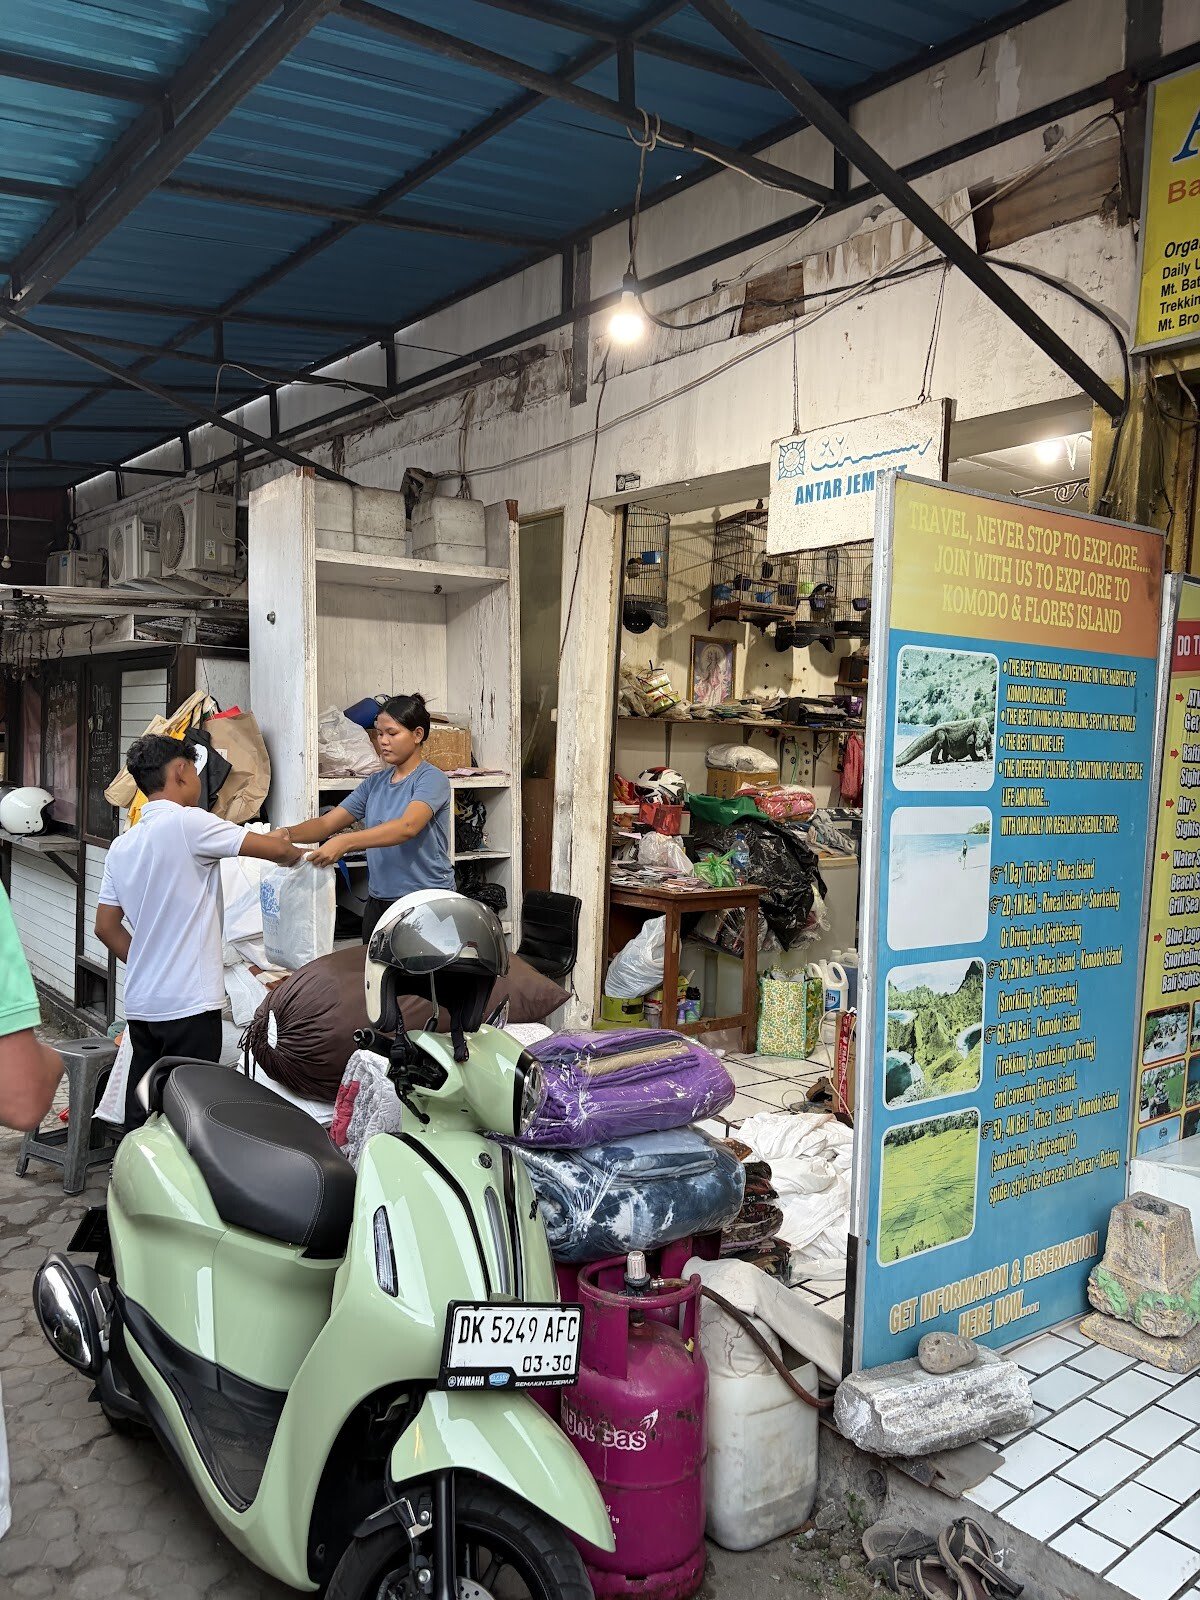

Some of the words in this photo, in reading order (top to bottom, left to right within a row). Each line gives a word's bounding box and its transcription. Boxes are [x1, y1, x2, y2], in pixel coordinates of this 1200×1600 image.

[1164, 238, 1200, 259] Orga
[1162, 261, 1191, 280] Daily
[1160, 283, 1178, 297] Mt.
[1158, 318, 1175, 333] Mt.
[1179, 313, 1200, 327] Bro
[794, 477, 843, 506] ANTAR
[845, 464, 908, 496] JEM
[908, 502, 974, 546] TRAVEL,
[976, 514, 1025, 550] NEVER
[1027, 528, 1062, 557] STOP
[1064, 533, 1082, 560] TO
[934, 545, 971, 576] JOIN
[973, 550, 1013, 585] WITH
[1015, 560, 1034, 587] US
[1035, 562, 1053, 590] TO
[1055, 565, 1113, 601] EXPLORE
[1114, 577, 1131, 604] TO
[942, 584, 1010, 620] KOMODO
[1011, 594, 1022, 622] &
[1024, 596, 1074, 630] FLORES
[1076, 605, 1122, 636] ISLAND
[1177, 635, 1191, 657] DO
[1008, 658, 1020, 677] THE
[1020, 659, 1034, 678] BEST
[1035, 660, 1062, 681] TREKKING
[1062, 664, 1092, 684] ADVENTURE
[1092, 667, 1099, 684] IN
[1099, 667, 1109, 686] THE
[1109, 669, 1130, 688] HABITAT
[1129, 671, 1137, 688] OF
[1007, 684, 1032, 704] KOMODO
[1032, 685, 1054, 705] DRAGON
[1054, 687, 1067, 706] LIVE
[1006, 706, 1018, 726] THE
[1018, 707, 1033, 727] BEST
[1033, 708, 1052, 728] DIVING
[1052, 710, 1060, 728] OR
[1089, 713, 1103, 731] SPOT
[1102, 713, 1109, 731] IN
[1109, 714, 1119, 732] THE
[1119, 714, 1137, 733] WORLD
[1184, 712, 1200, 733] Get
[1004, 732, 1016, 751] THE
[1016, 733, 1032, 752] BEST
[1031, 734, 1053, 753] NATURE
[1053, 735, 1064, 753] LIFE
[1004, 758, 1016, 778] THE
[1015, 758, 1046, 779] DIFFERENT
[1046, 759, 1070, 780] CULTURE
[1070, 759, 1076, 780] &
[1075, 760, 1103, 780] TRADITION
[1102, 760, 1110, 780] OF
[1110, 761, 1125, 781] LOCAL
[1125, 762, 1144, 781] PEOPLE
[1001, 787, 1015, 807] LIFE
[1015, 787, 1027, 807] AND
[1000, 815, 1016, 836] WITH
[1016, 815, 1029, 836] OUR
[1029, 815, 1045, 836] DAILY
[1045, 815, 1053, 835] OR
[1053, 814, 1077, 835] REGULAR
[1077, 814, 1103, 834] SCHEDULE
[1173, 849, 1196, 869] Water
[1003, 861, 1008, 884] 1
[1009, 861, 1023, 889] Day
[1023, 860, 1037, 888] Trip
[1037, 859, 1052, 883] Bali
[1056, 858, 1075, 881] Rinca
[1076, 857, 1096, 880] Island
[1170, 872, 1195, 892] Beach
[1023, 891, 1037, 915] Bali
[1063, 888, 1083, 911] Island
[1088, 885, 1121, 912] Snorkeling
[1168, 896, 1186, 916] Grill
[1185, 895, 1200, 914] Sea
[1000, 925, 1010, 949] Or
[1009, 924, 1032, 951] Diving
[1032, 921, 1046, 945] And
[1045, 919, 1083, 948] Sightseeing
[1165, 927, 1183, 947] Blue
[1020, 954, 1035, 978] Bali
[1080, 948, 1104, 971] Komodo
[1033, 985, 1039, 1007] &
[1162, 973, 1177, 994] Bali
[1017, 1016, 1032, 1042] Bali
[1035, 1014, 1061, 1039] Komodo
[1061, 1009, 1081, 1034] island
[1027, 1048, 1034, 1070] &
[1034, 1042, 1068, 1069] snorkeling
[1067, 1043, 1075, 1058] or
[994, 1084, 1008, 1109] and
[1008, 1079, 1037, 1105] covering
[1036, 1075, 1056, 1098] Flores
[1016, 1110, 1030, 1135] Bali
[1033, 1107, 1052, 1130] Rinca
[1054, 1100, 1074, 1124] island
[1078, 1094, 1101, 1118] Komodo
[1101, 1088, 1120, 1112] island
[1029, 1139, 1035, 1161] &
[1070, 1128, 1077, 1150] to
[989, 1179, 1011, 1208] spider
[1011, 1172, 1028, 1201] style
[1028, 1170, 1041, 1192] rice
[1065, 1159, 1073, 1180] in
[1073, 1156, 1095, 1178] Cancar
[1099, 1147, 1120, 1170] Ruteng
[889, 1297, 919, 1335] GET
[919, 1262, 1009, 1324] INFORMATION
[1010, 1258, 1022, 1287] &
[1023, 1230, 1099, 1283] RESERVATION
[458, 1315, 485, 1344] DK
[490, 1316, 538, 1344] 5249
[543, 1316, 578, 1343] AFC
[957, 1301, 993, 1340] HERE
[456, 1376, 485, 1387] YAMAHA
[515, 1380, 545, 1388] SEMAKIN
